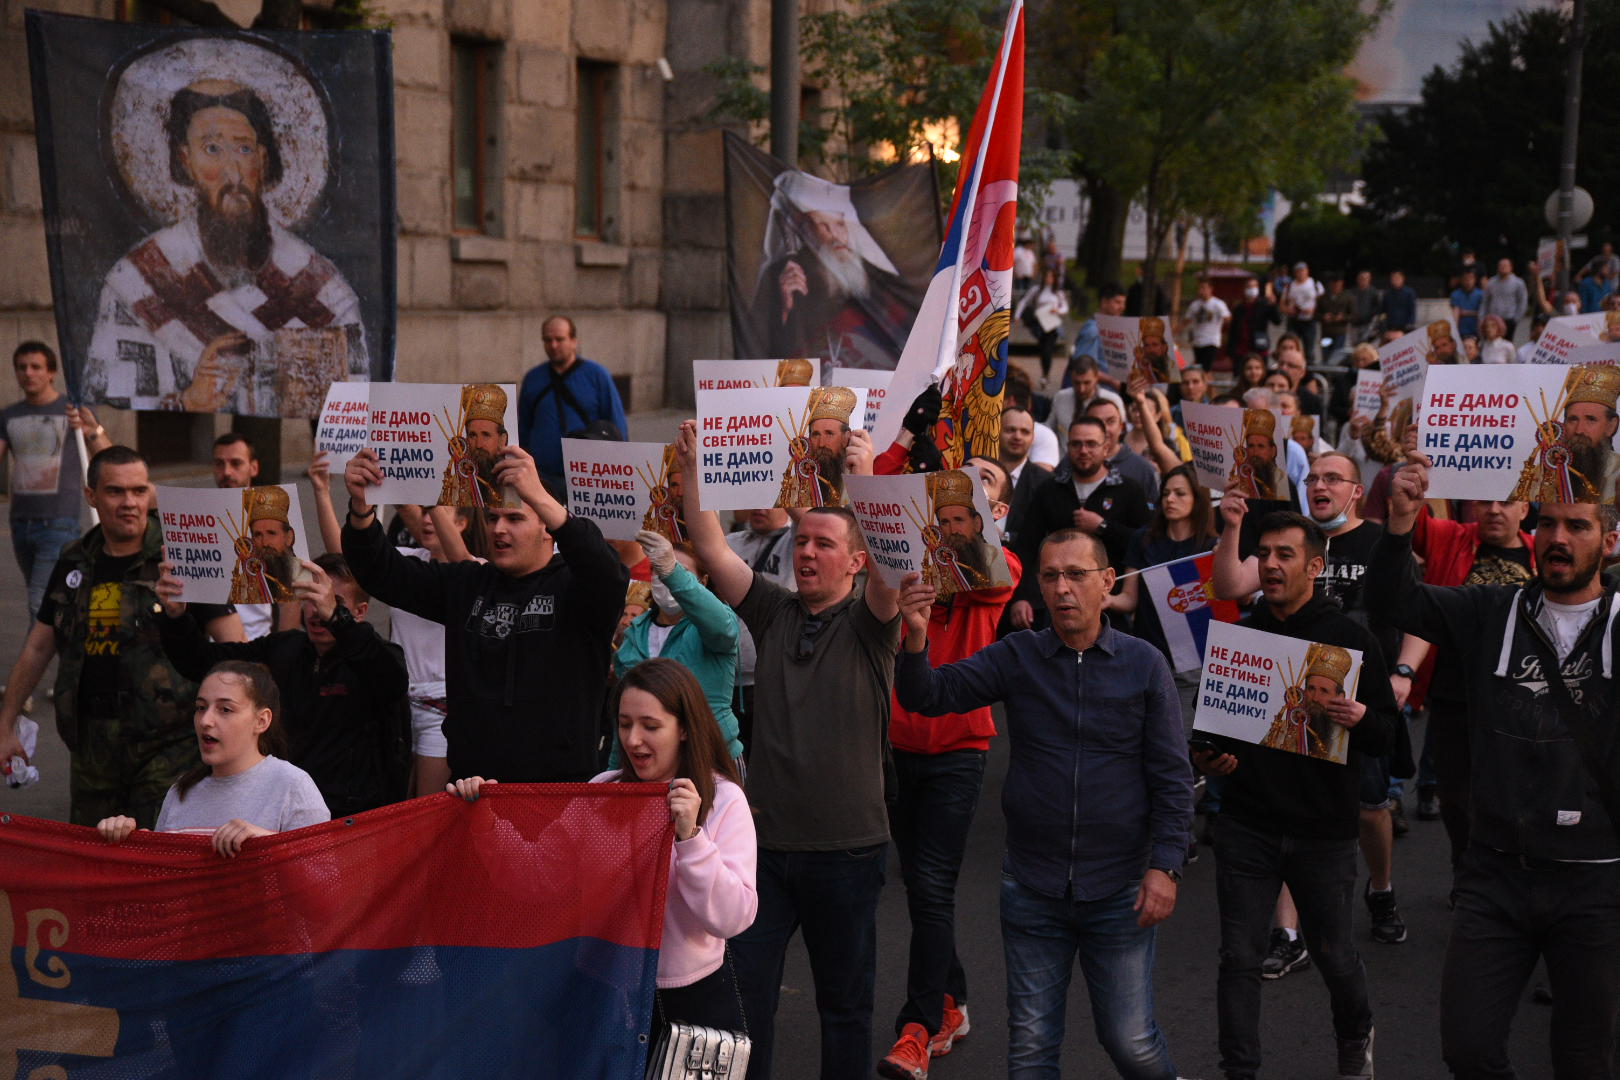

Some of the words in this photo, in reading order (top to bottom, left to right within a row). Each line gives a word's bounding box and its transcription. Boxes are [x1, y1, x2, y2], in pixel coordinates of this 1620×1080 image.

[700, 380, 714, 390] НЕ
[717, 380, 752, 390] ДАМО
[328, 401, 342, 411] НЕ
[1430, 393, 1456, 408] НЕ
[1459, 393, 1519, 411] ДАМО
[371, 411, 387, 424] НЕ
[389, 411, 431, 428] ДАМО
[703, 417, 722, 430] НЕ
[726, 415, 773, 432] ДАМО
[1427, 413, 1516, 428] СВЕТИЊЕ!
[321, 428, 334, 439] НЕ
[335, 429, 367, 441] ДАМО
[370, 430, 433, 443] СВЕТИЊЕ!
[1187, 421, 1197, 432] НЕ
[1198, 423, 1223, 437] ДАМО
[703, 433, 772, 448] СВЕТИЊЕ!
[1425, 433, 1450, 448] НЕ
[1454, 434, 1514, 452] ДАМО
[390, 448, 434, 464] ДАМО
[703, 453, 723, 466] НЕ
[727, 451, 773, 469] ДАМО
[1202, 449, 1224, 464] ДАМО
[379, 467, 436, 480] ЛАДИКУ!
[569, 461, 588, 473] НЕ
[592, 463, 634, 477] ДАМО
[571, 477, 634, 490] СВЕТИЊЕ!
[704, 470, 774, 485] ВЛАДИКУ!
[573, 490, 590, 502] НЕ
[594, 493, 636, 506] ДАМО
[574, 506, 636, 520] ВЛАДИКУ!
[854, 501, 868, 515] НЕ
[869, 502, 902, 519] ДАМО
[163, 512, 177, 526] НЕ
[180, 513, 216, 530] ДАМО
[861, 519, 906, 534] СВЕТИЊЕ!
[165, 531, 219, 544] СВЕТИЊЕ!
[866, 535, 880, 550] НЕ
[879, 538, 910, 554] ДАМО
[168, 547, 182, 560] НЕ
[185, 549, 222, 564] ДАМО
[873, 553, 914, 571] ВЛАДИКУ!
[1210, 645, 1229, 661] НЕ
[1230, 650, 1273, 671] ДАМО
[1208, 663, 1270, 687] СВЕТИЊЕ!
[1205, 678, 1223, 694] НЕ
[1226, 684, 1269, 704] ДАМО
[1203, 695, 1266, 720] ВЛАДИКУ!
